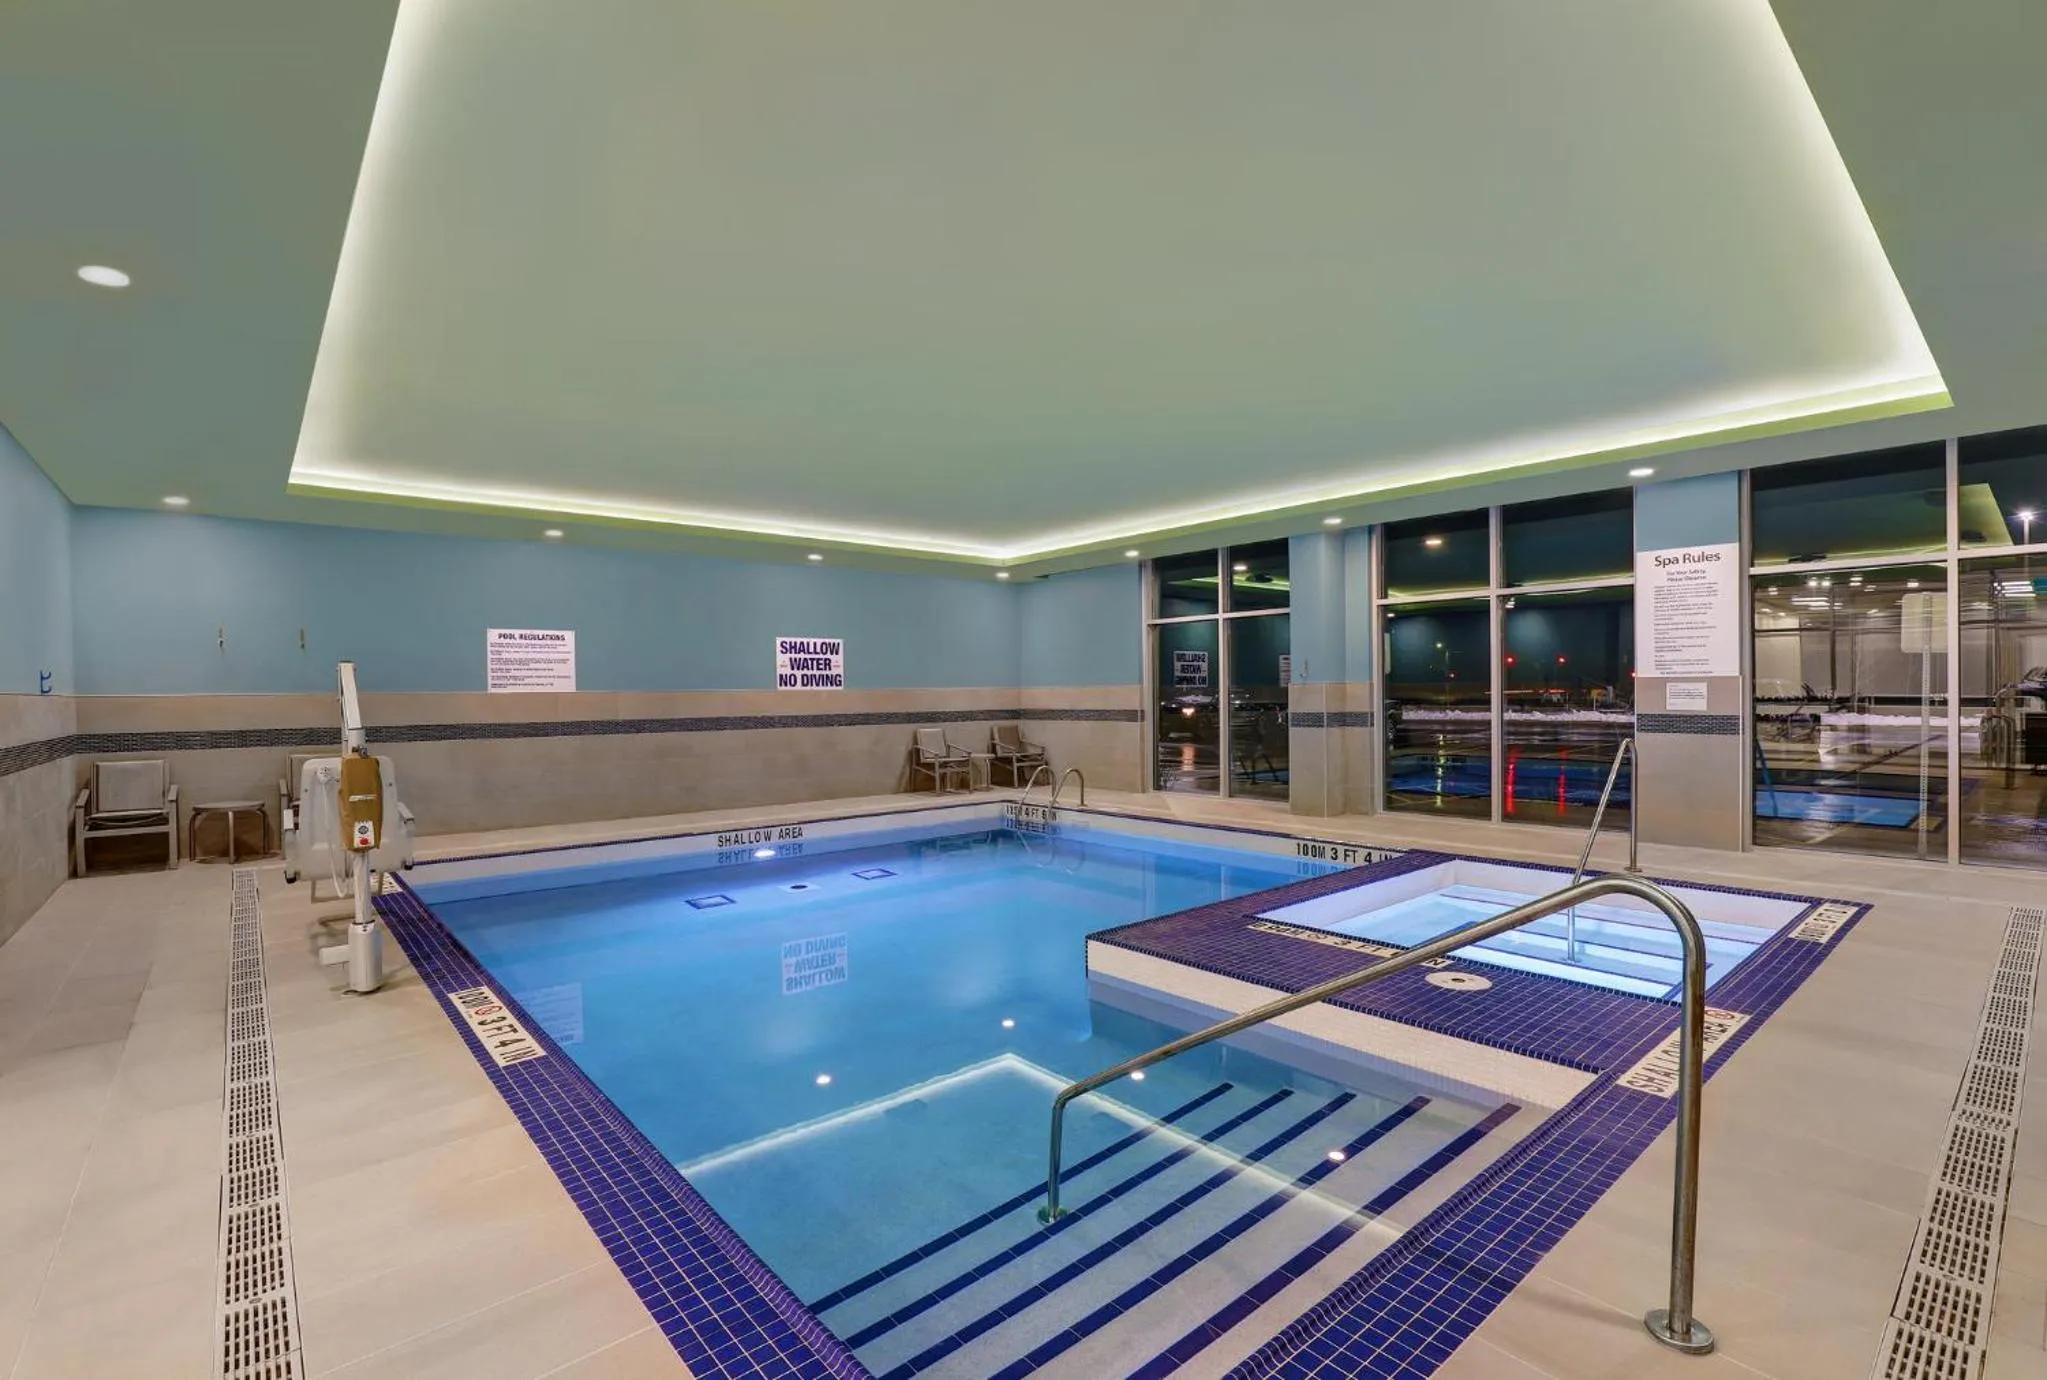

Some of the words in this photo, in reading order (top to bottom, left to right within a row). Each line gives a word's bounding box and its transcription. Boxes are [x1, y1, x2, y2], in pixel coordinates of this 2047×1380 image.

[1654, 555, 1679, 568] Spa
[1682, 551, 1722, 564] Rules
[519, 633, 566, 641] REGULATIONS
[780, 641, 840, 655] SHALLOW
[789, 657, 832, 671] WATER
[779, 673, 798, 687] NO
[801, 673, 842, 687] DIVING
[718, 829, 772, 847] SHALLOW
[778, 827, 803, 840] AREA
[1296, 842, 1326, 859] 100M
[1330, 847, 1338, 861] 3
[1343, 849, 1358, 864] FT
[1364, 851, 1372, 865] 4
[477, 1016, 507, 1026] 3
[482, 1023, 519, 1038] FT
[494, 1038, 526, 1049] 4
[500, 1046, 538, 1063] IN
